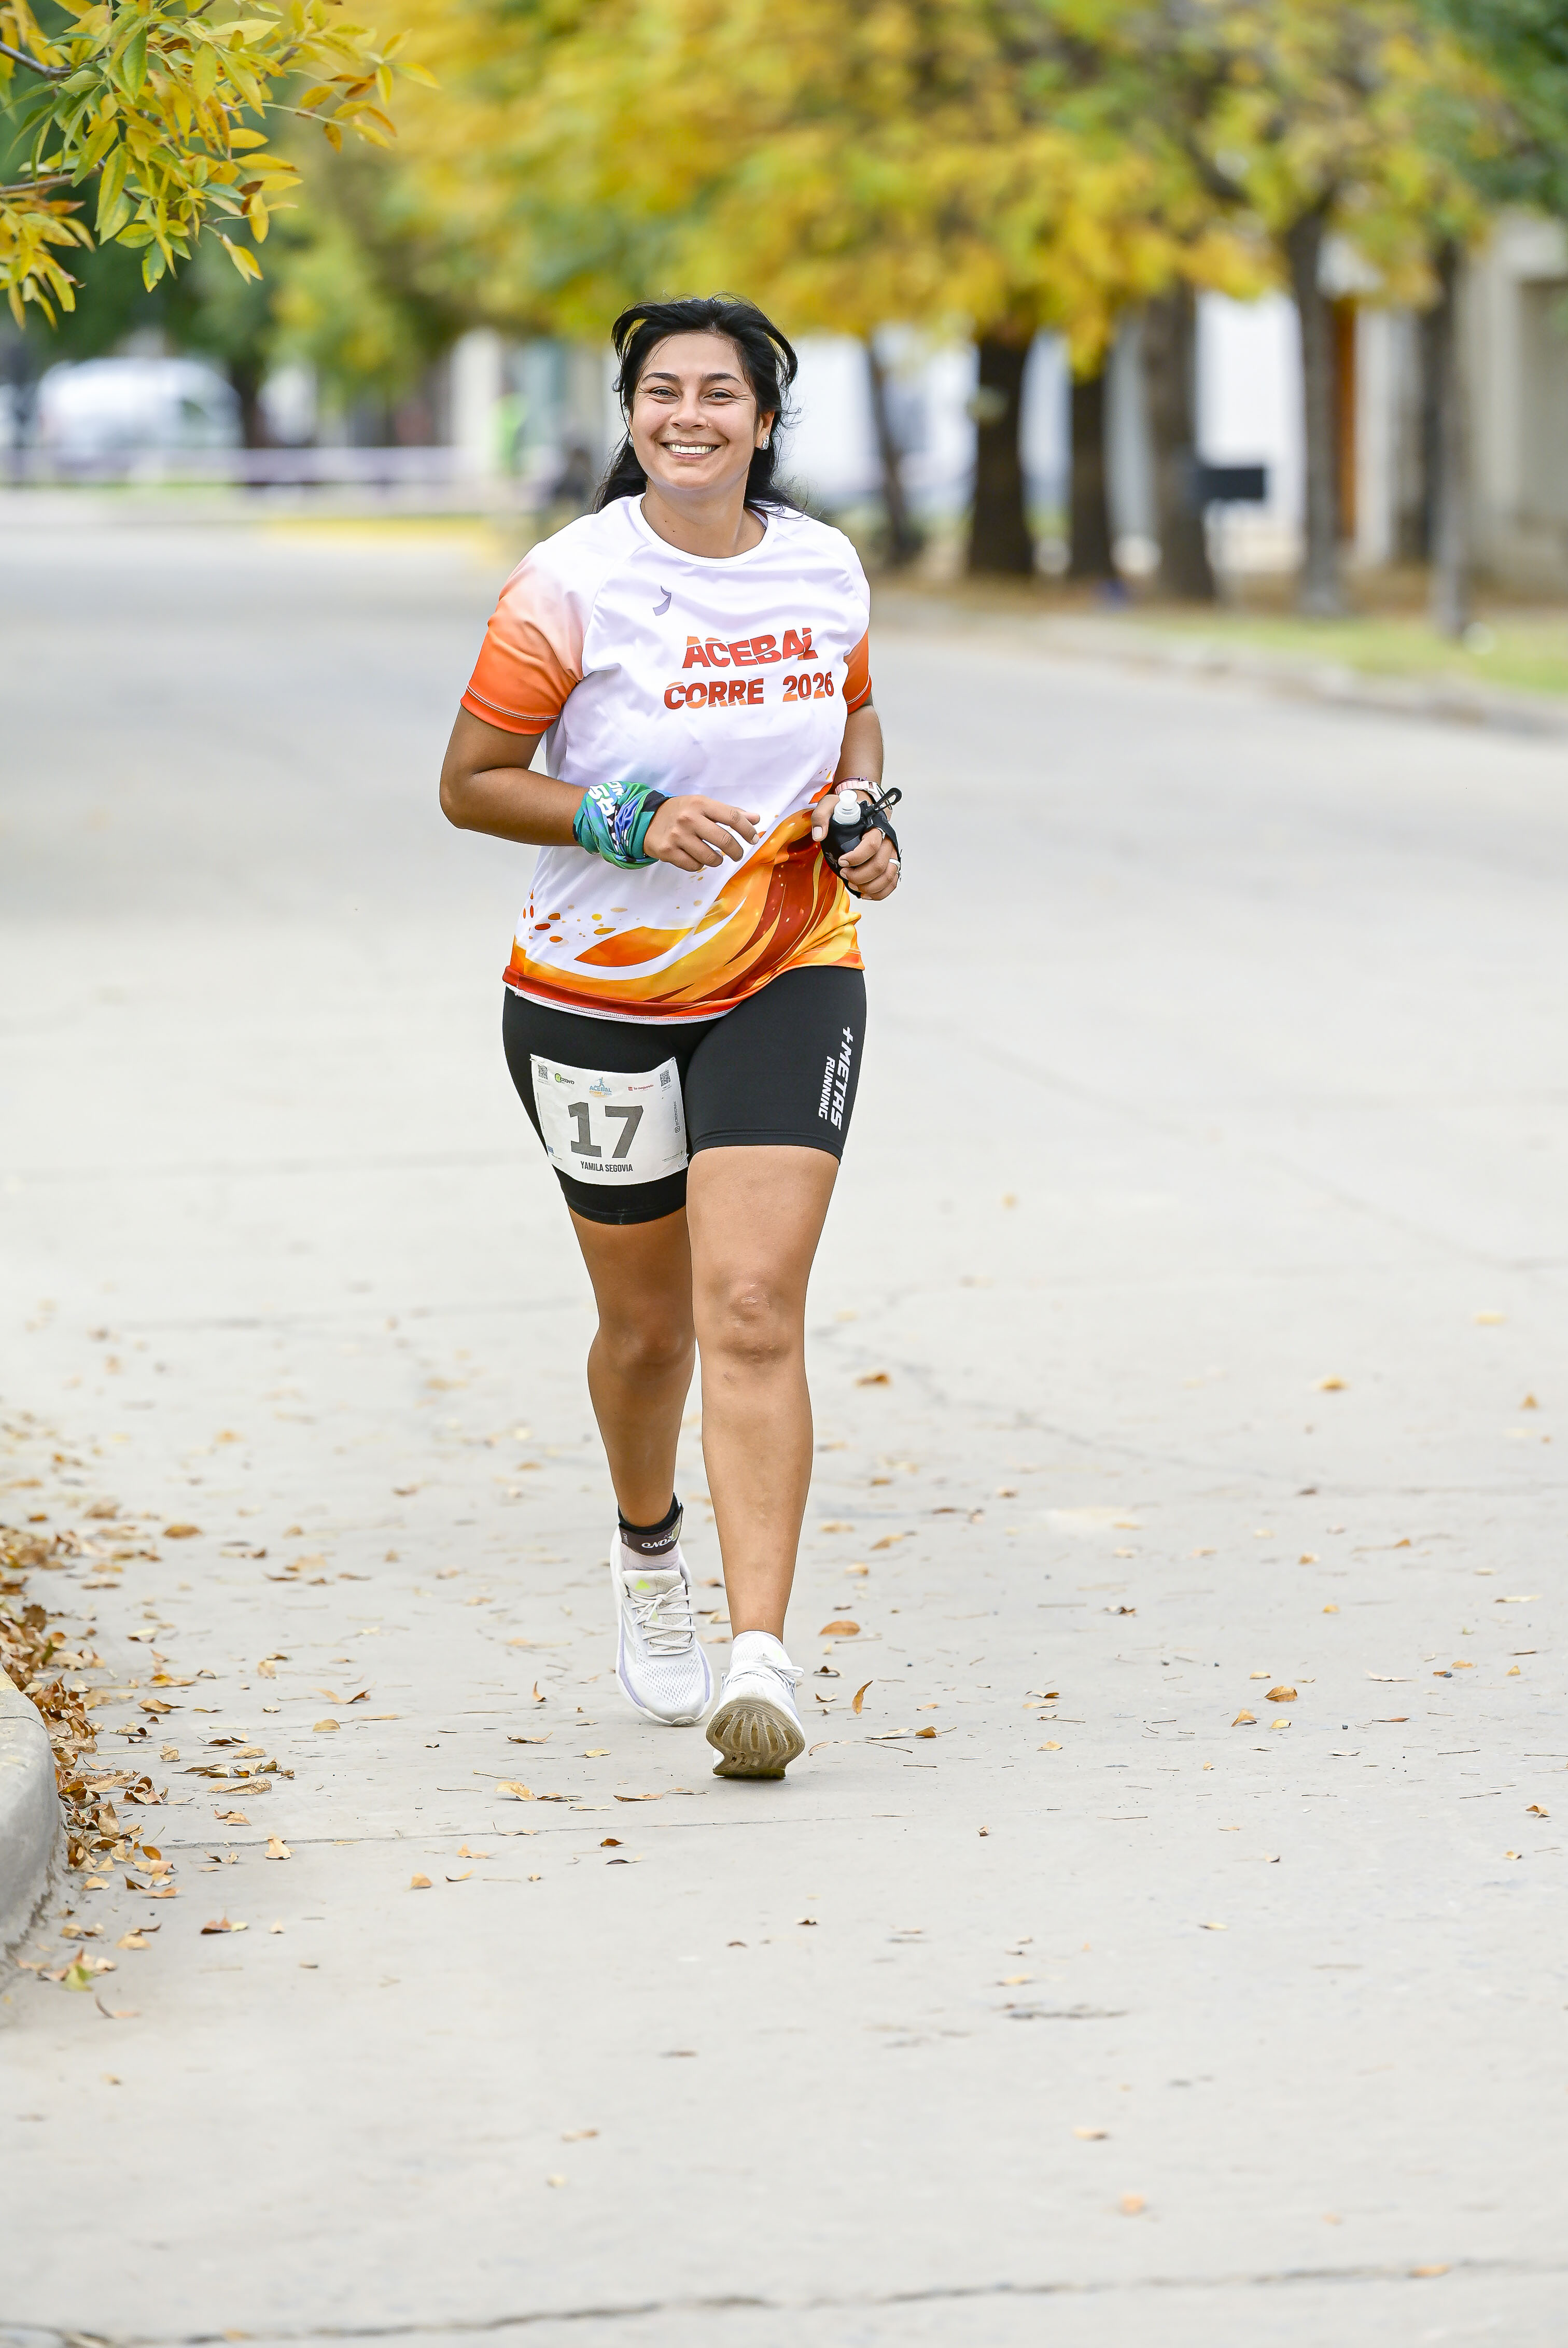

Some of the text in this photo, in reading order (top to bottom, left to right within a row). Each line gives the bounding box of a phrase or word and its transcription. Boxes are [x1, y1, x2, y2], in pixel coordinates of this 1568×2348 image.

[682, 627, 819, 668] ACEBAL
[664, 671, 834, 710] CORRE 2026
[818, 1056, 835, 1120] RUNNING
[567, 1101, 644, 1158] 17
[580, 1161, 634, 1172] YAMILA SEGOVIA
